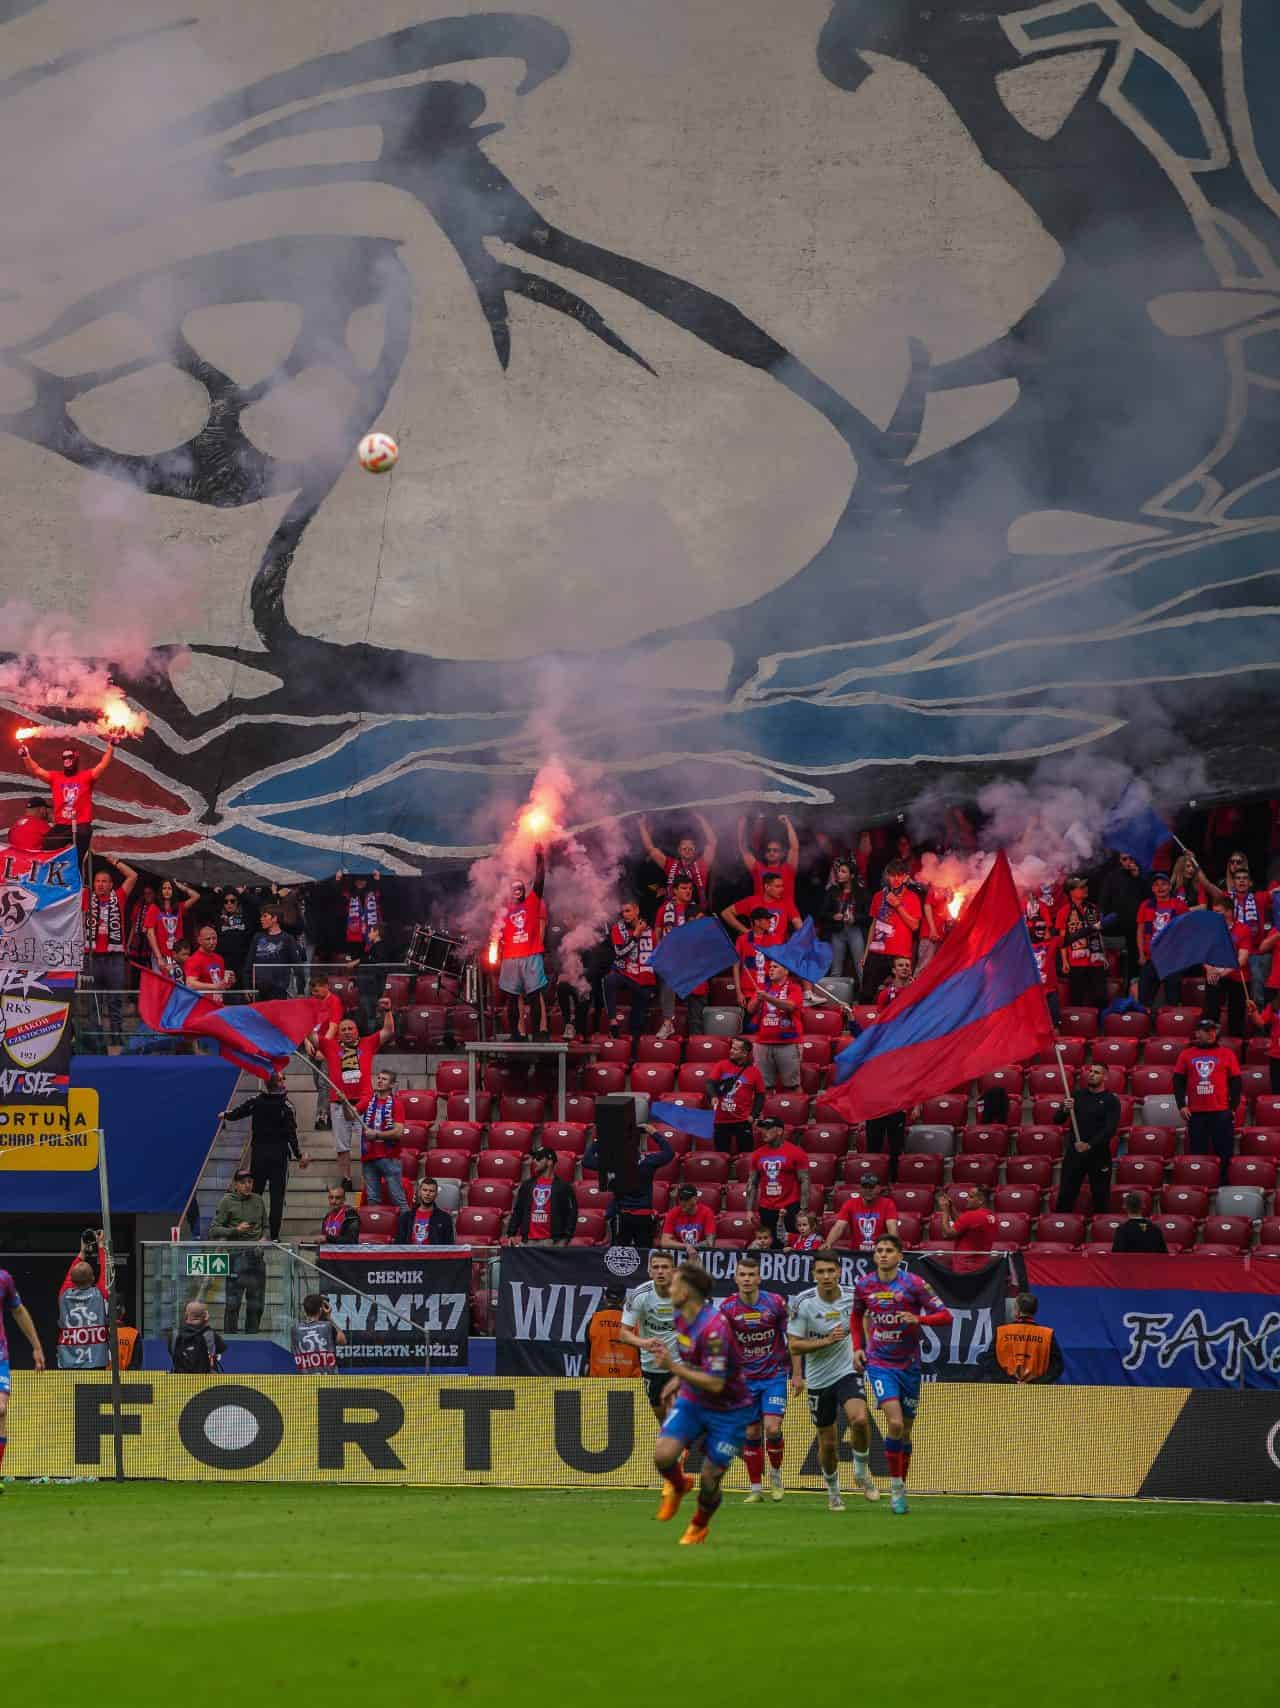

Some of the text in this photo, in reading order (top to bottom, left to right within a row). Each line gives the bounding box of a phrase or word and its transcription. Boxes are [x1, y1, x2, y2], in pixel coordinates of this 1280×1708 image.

[6, 1001, 31, 1014] RKS
[39, 1133, 88, 1147] POLSKI
[760, 1252, 868, 1286] BROTRS
[367, 1271, 423, 1284] CHEMIK
[327, 1293, 467, 1331] WM'17
[61, 1328, 107, 1344] PHOTO
[75, 1348, 93, 1364] 21
[336, 1342, 459, 1359] ĘDZIERZYN-KOŹLE
[294, 1352, 337, 1369] PHOTO
[874, 1379, 885, 1397] 8
